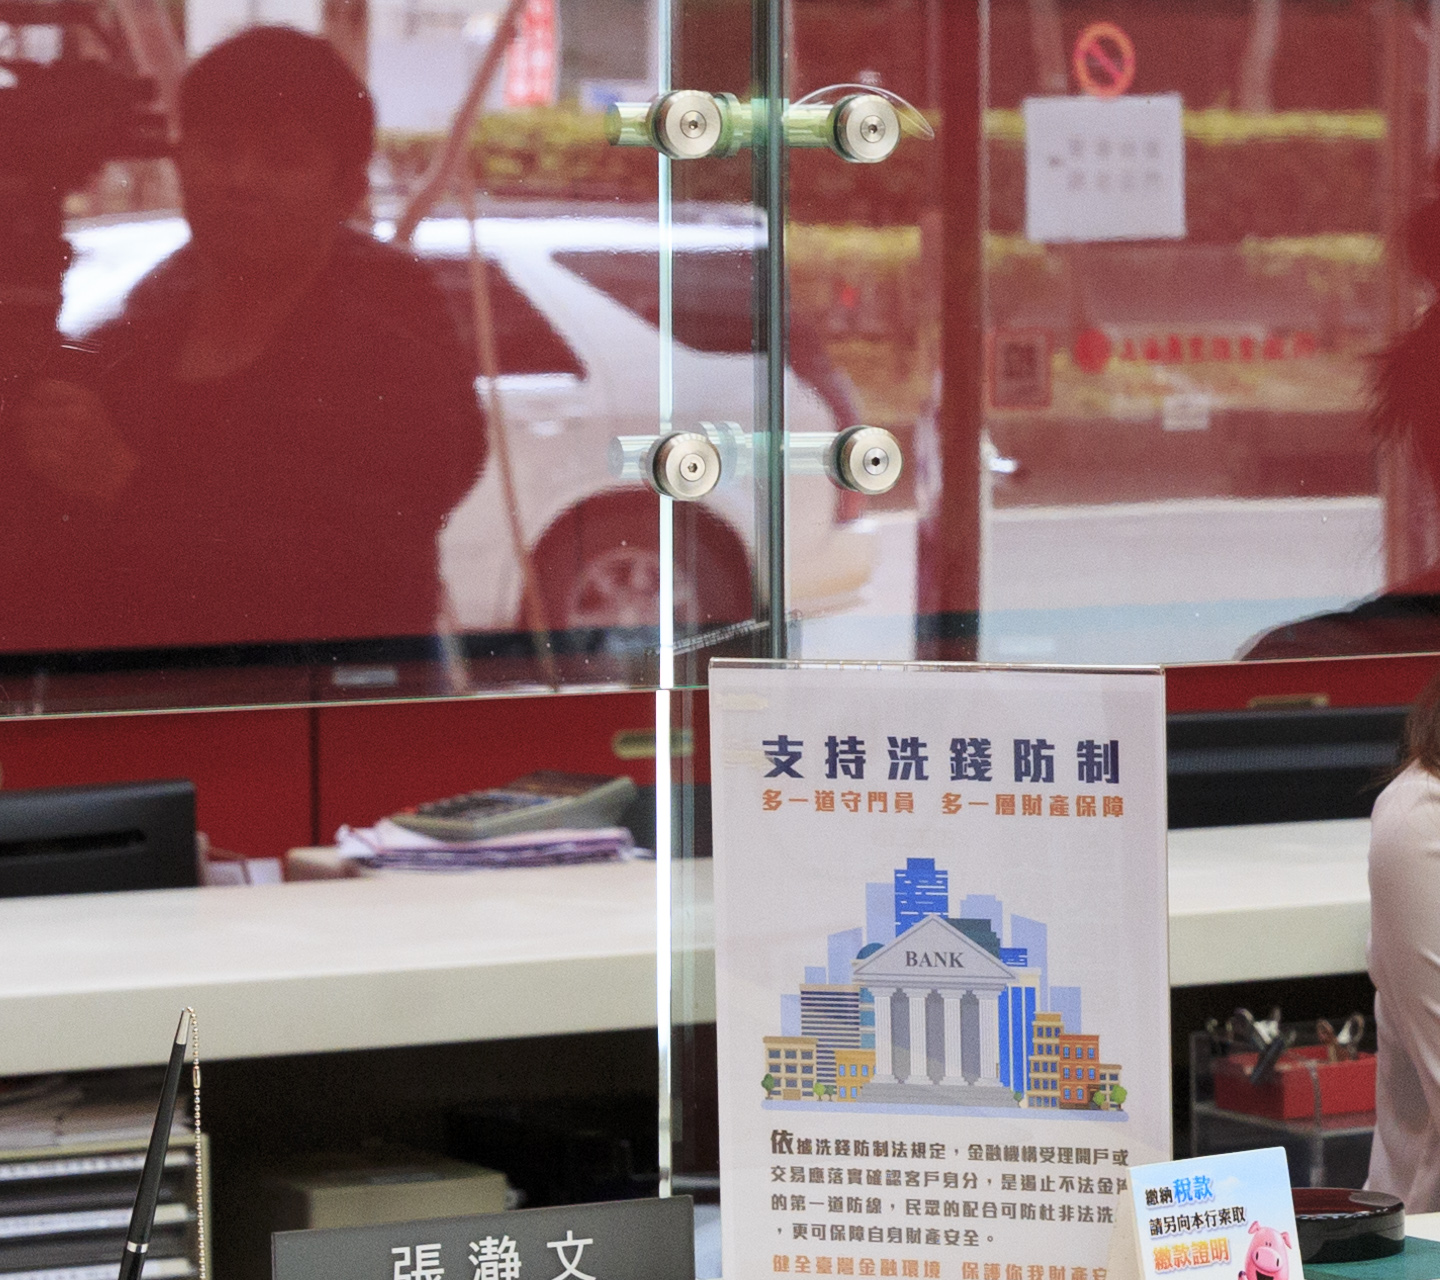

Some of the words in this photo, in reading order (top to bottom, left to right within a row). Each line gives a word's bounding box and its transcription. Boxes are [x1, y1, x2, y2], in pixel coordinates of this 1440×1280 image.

[761, 734, 1120, 784] 支持洗錢防制
[761, 788, 916, 814] 多一道守門員
[940, 791, 1125, 819] 多一層財產保障
[905, 950, 965, 969] BANK
[1145, 1175, 1213, 1207] 繳納稅款
[1149, 1206, 1246, 1237] 請另向本行索取
[772, 1254, 941, 1279] 健全臺灣金融環境
[1153, 1237, 1229, 1271] 繳款證明
